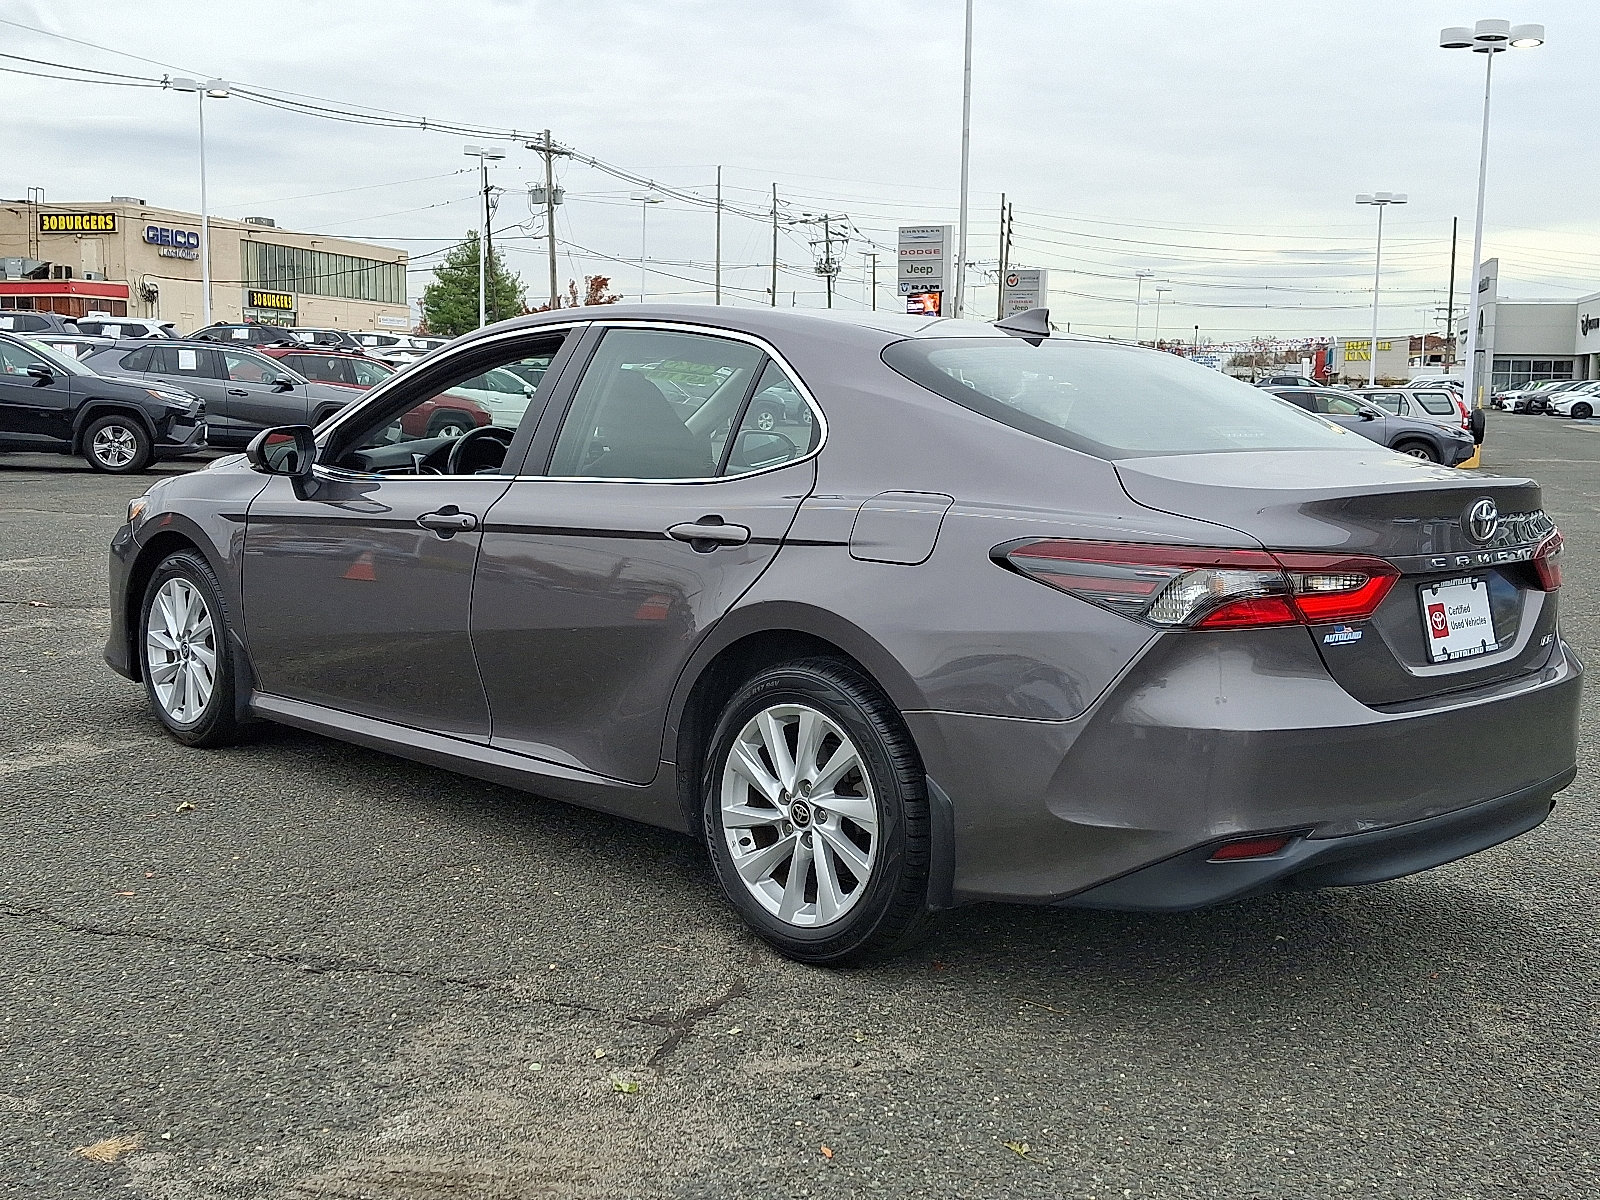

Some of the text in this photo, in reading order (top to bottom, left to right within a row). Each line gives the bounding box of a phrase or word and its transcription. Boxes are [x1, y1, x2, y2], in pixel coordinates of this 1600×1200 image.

[42, 215, 114, 230] 30BURGERS
[146, 225, 200, 249] GEICO
[900, 248, 940, 256] DODGE
[906, 263, 933, 275] Jeep
[253, 292, 292, 309] 30BURGERS
[1448, 603, 1471, 616] Certified
[1450, 616, 1487, 631] Used Vehicles
[1324, 631, 1363, 643] AUTOLAND
[1450, 646, 1484, 659] AUTOLAND
